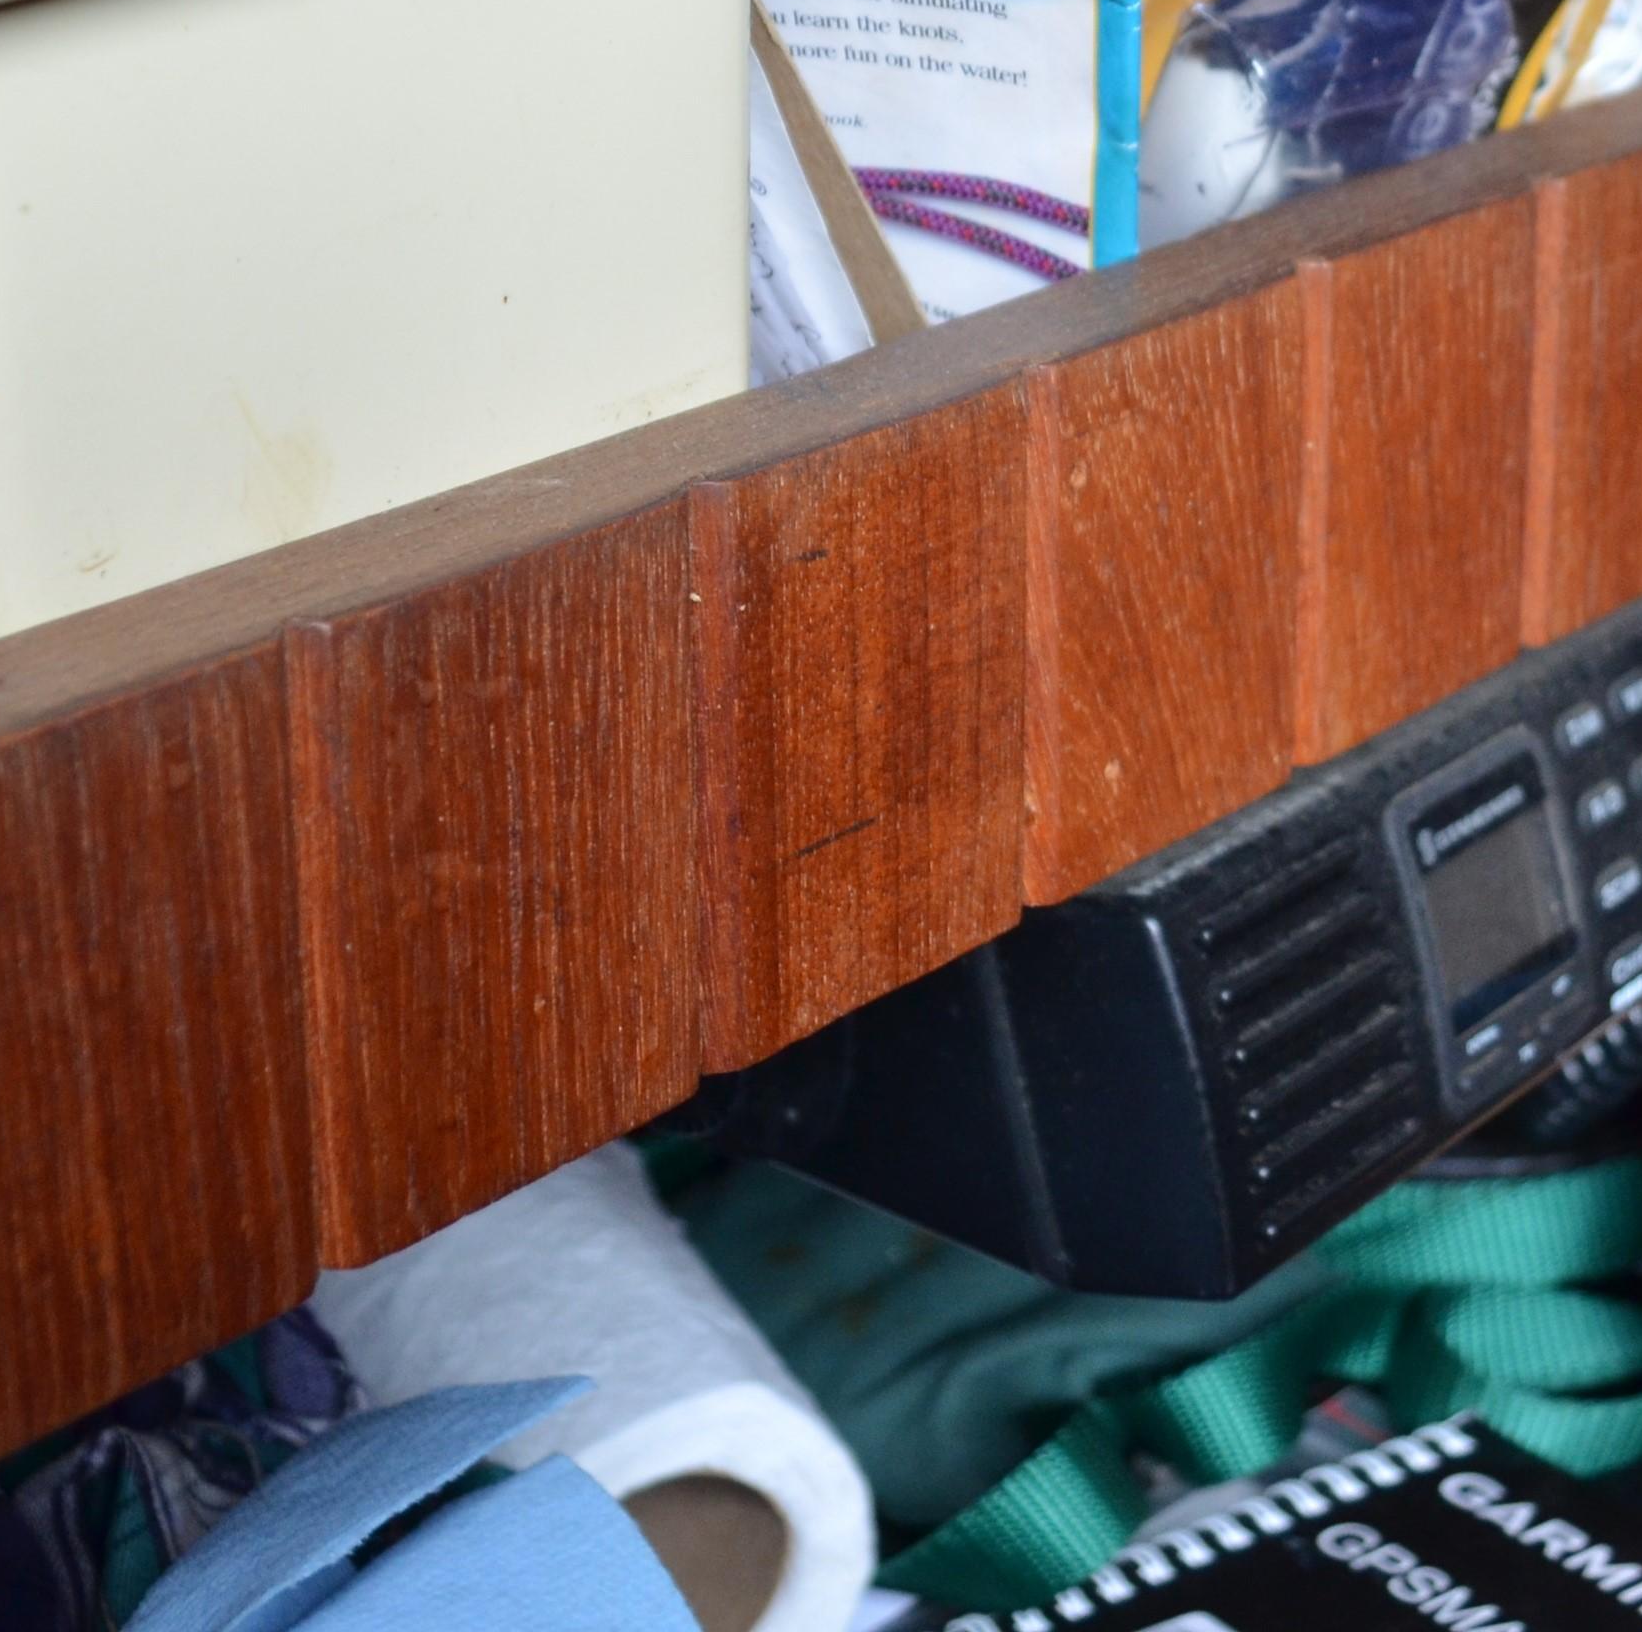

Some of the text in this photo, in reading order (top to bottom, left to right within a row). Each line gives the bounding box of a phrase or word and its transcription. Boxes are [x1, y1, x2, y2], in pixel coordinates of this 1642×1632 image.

[793, 11, 850, 31] learn
[857, 14, 892, 35] the
[899, 21, 965, 45] knots.
[844, 45, 1030, 88] fun on the water!
